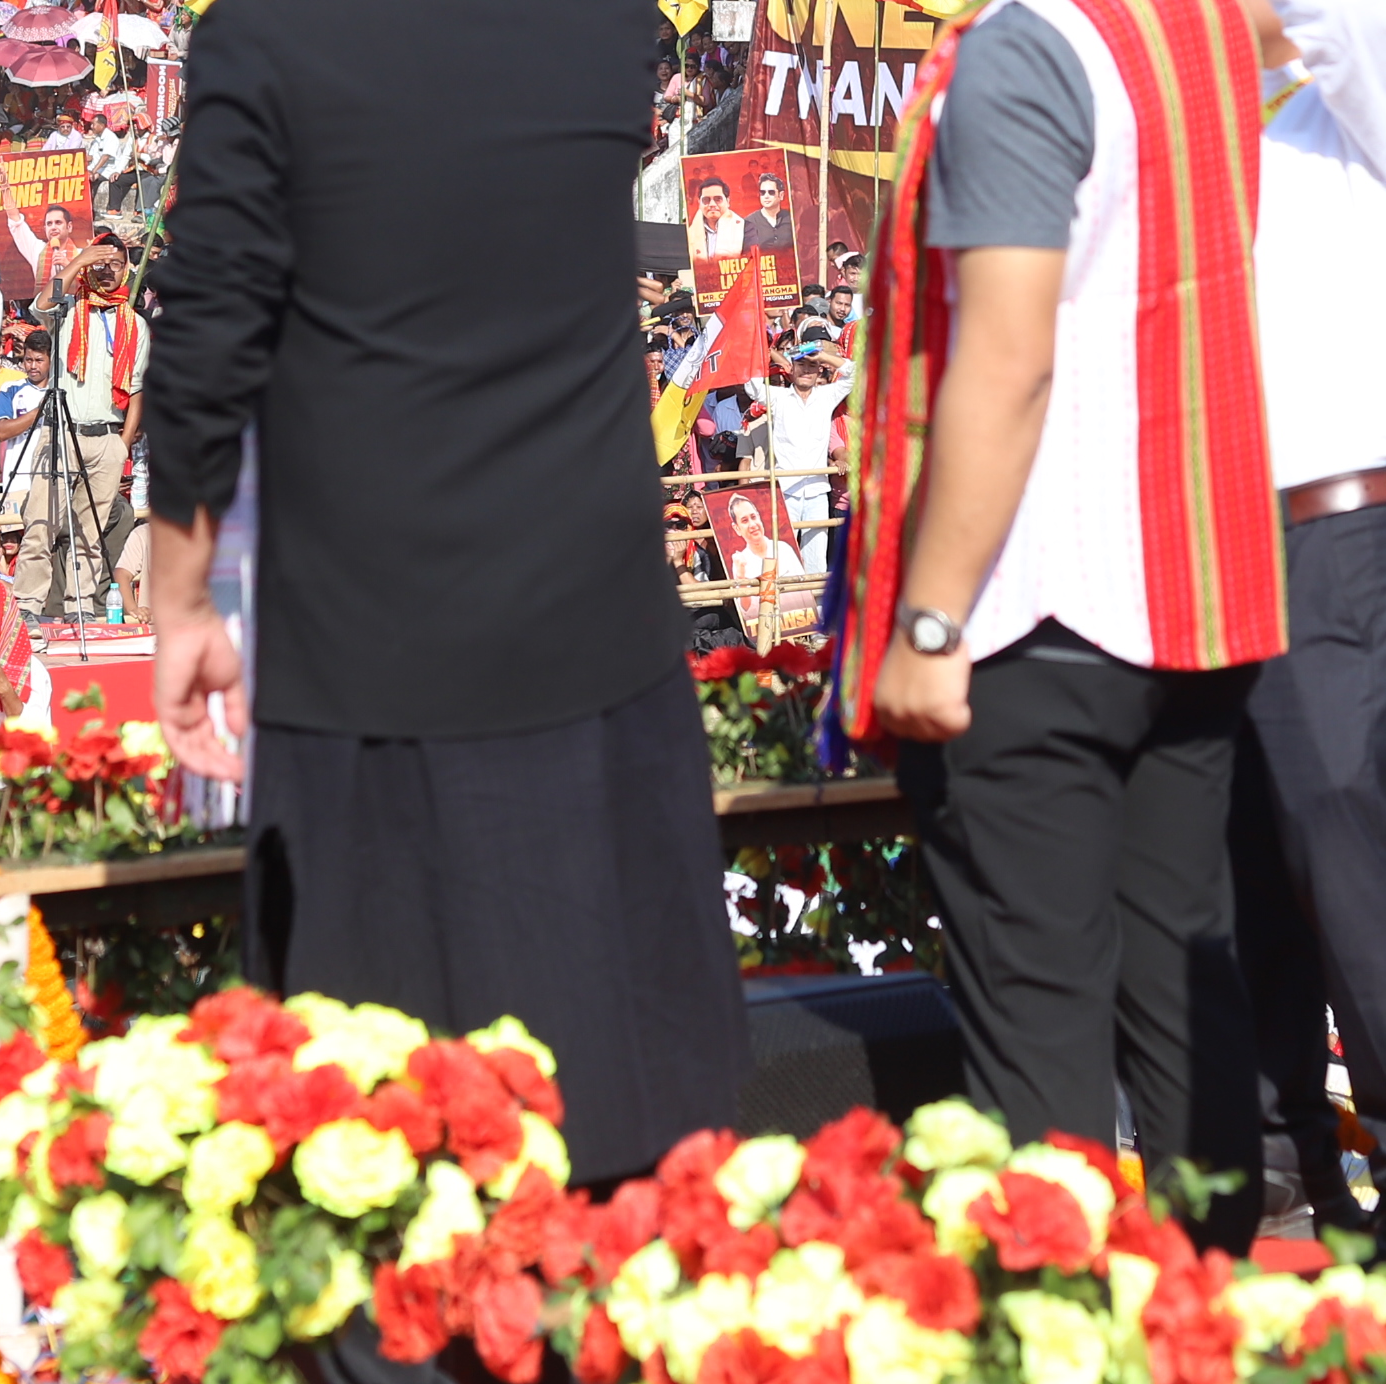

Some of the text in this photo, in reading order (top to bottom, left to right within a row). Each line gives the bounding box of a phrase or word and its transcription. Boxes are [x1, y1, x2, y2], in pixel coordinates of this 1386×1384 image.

[762, 51, 916, 127] THAN
[48, 177, 85, 204] LIVE
[718, 255, 776, 275] WELCME!
[703, 293, 717, 302] MR.
[746, 607, 818, 637] TNSA
